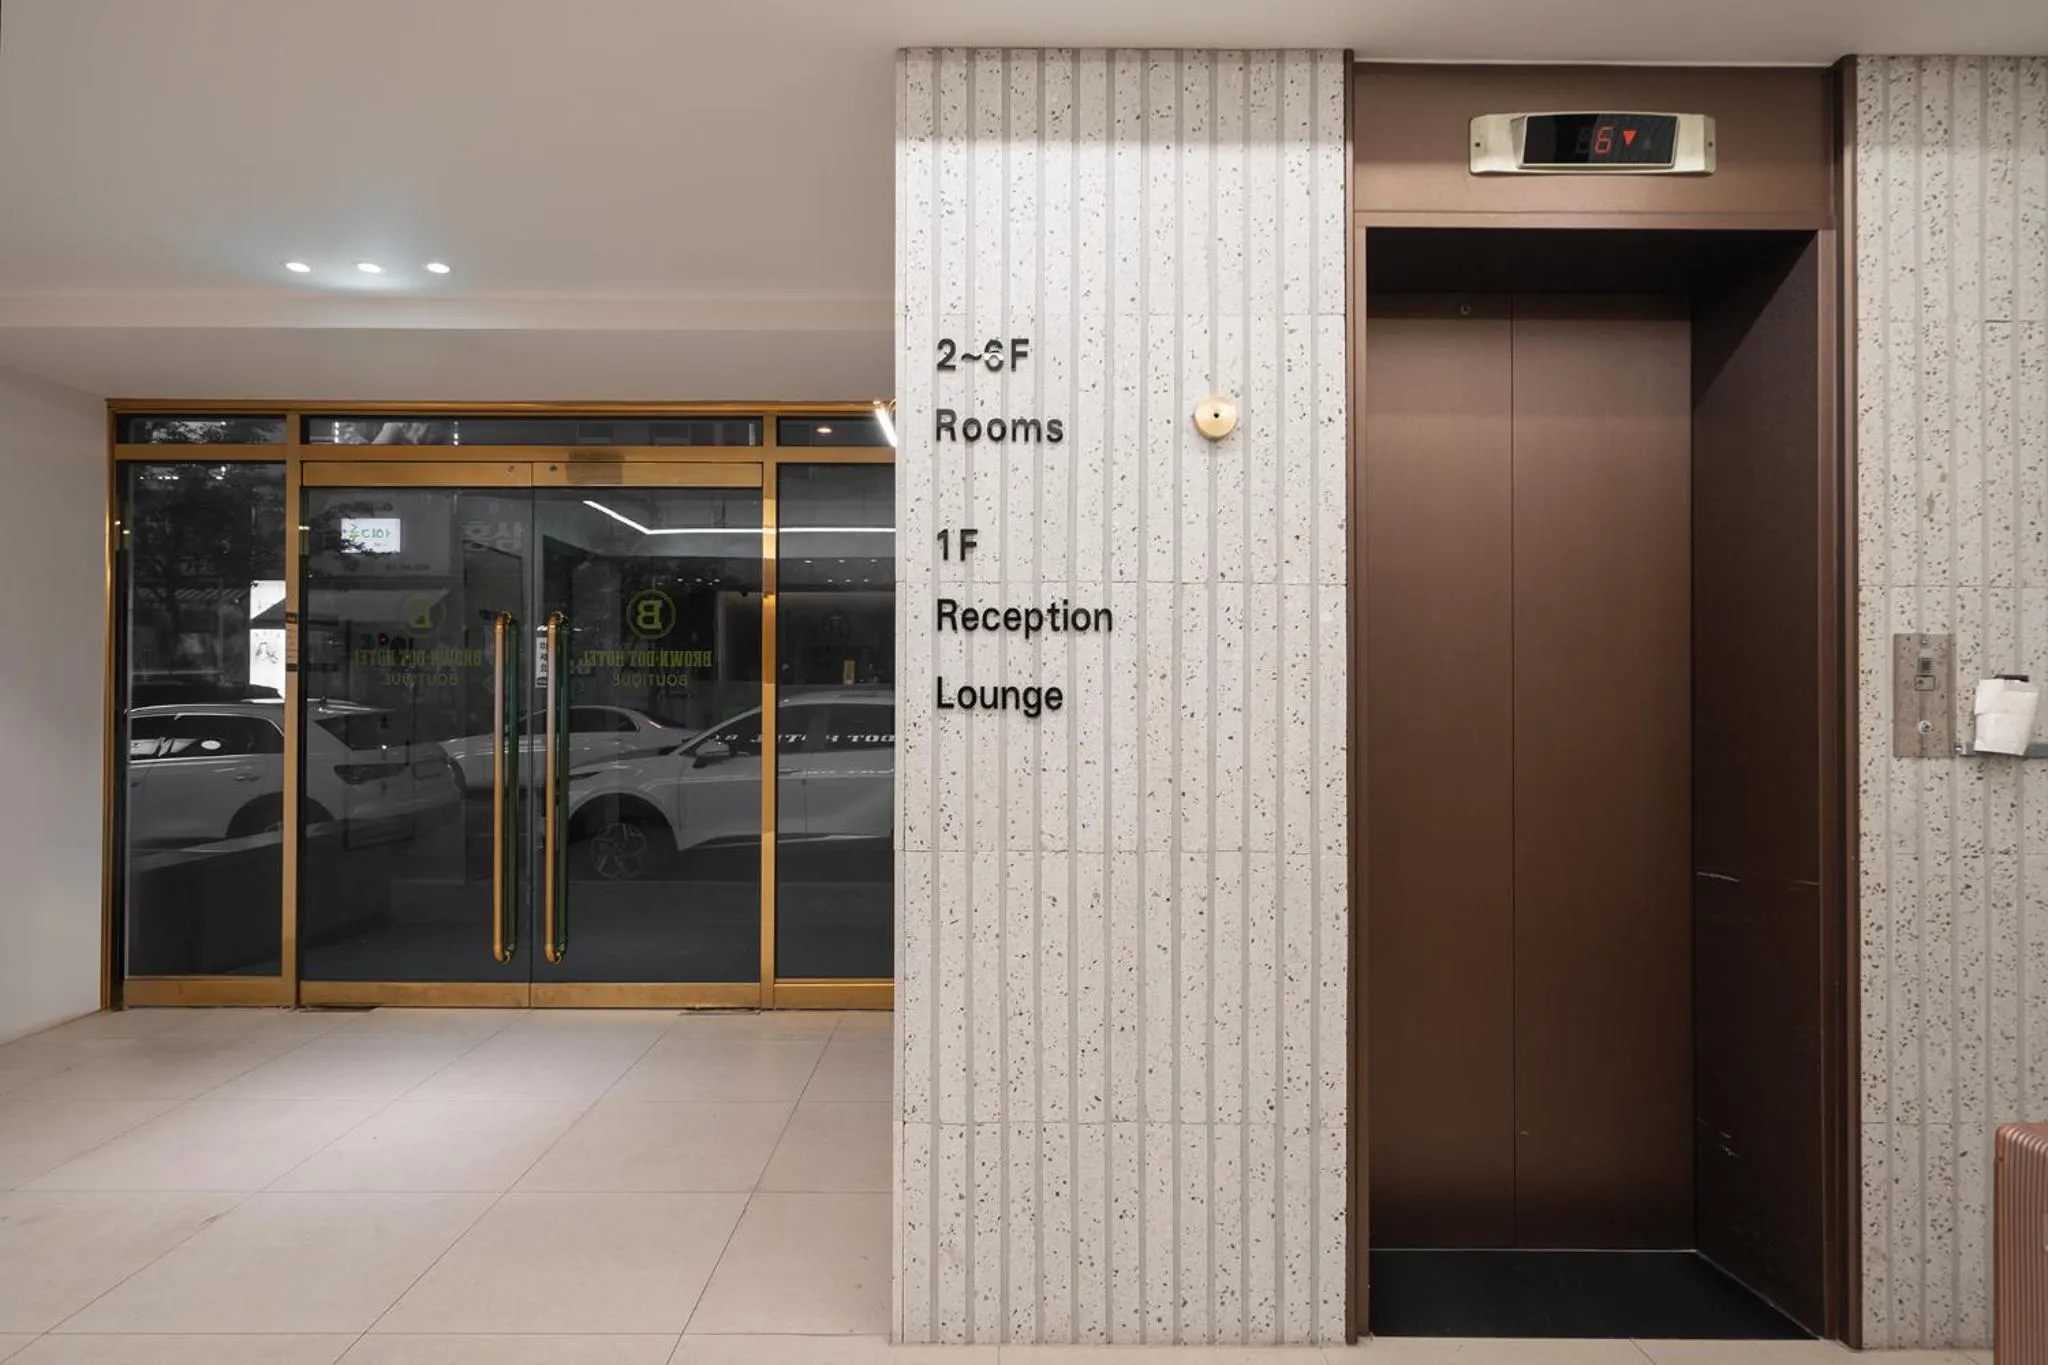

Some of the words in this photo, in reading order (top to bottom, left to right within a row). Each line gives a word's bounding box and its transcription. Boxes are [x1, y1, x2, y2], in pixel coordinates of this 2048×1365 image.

[1594, 126, 1614, 154] 6
[935, 408, 1064, 443] Rooms
[936, 529, 978, 561] 1F
[936, 599, 1114, 639] Reception
[936, 676, 1064, 718] Lounge
